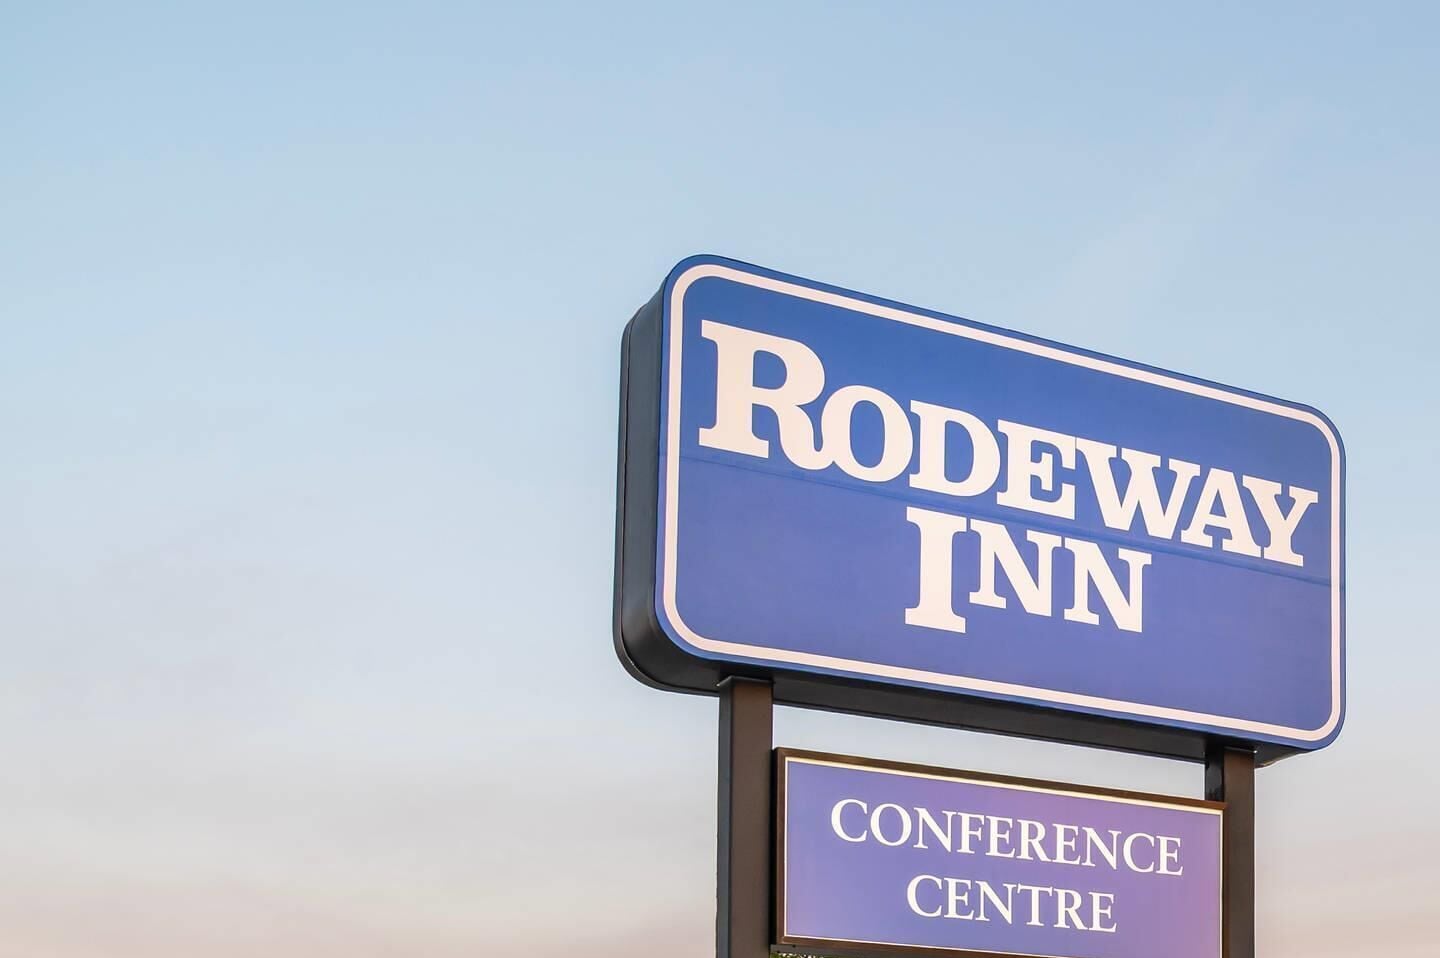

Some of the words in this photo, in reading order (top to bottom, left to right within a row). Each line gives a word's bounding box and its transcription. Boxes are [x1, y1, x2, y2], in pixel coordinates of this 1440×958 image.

[699, 319, 1318, 567] RODEWAY
[905, 507, 1152, 633] INN
[830, 798, 1184, 877] CONFERENCE
[906, 874, 1118, 934] CENTRE
